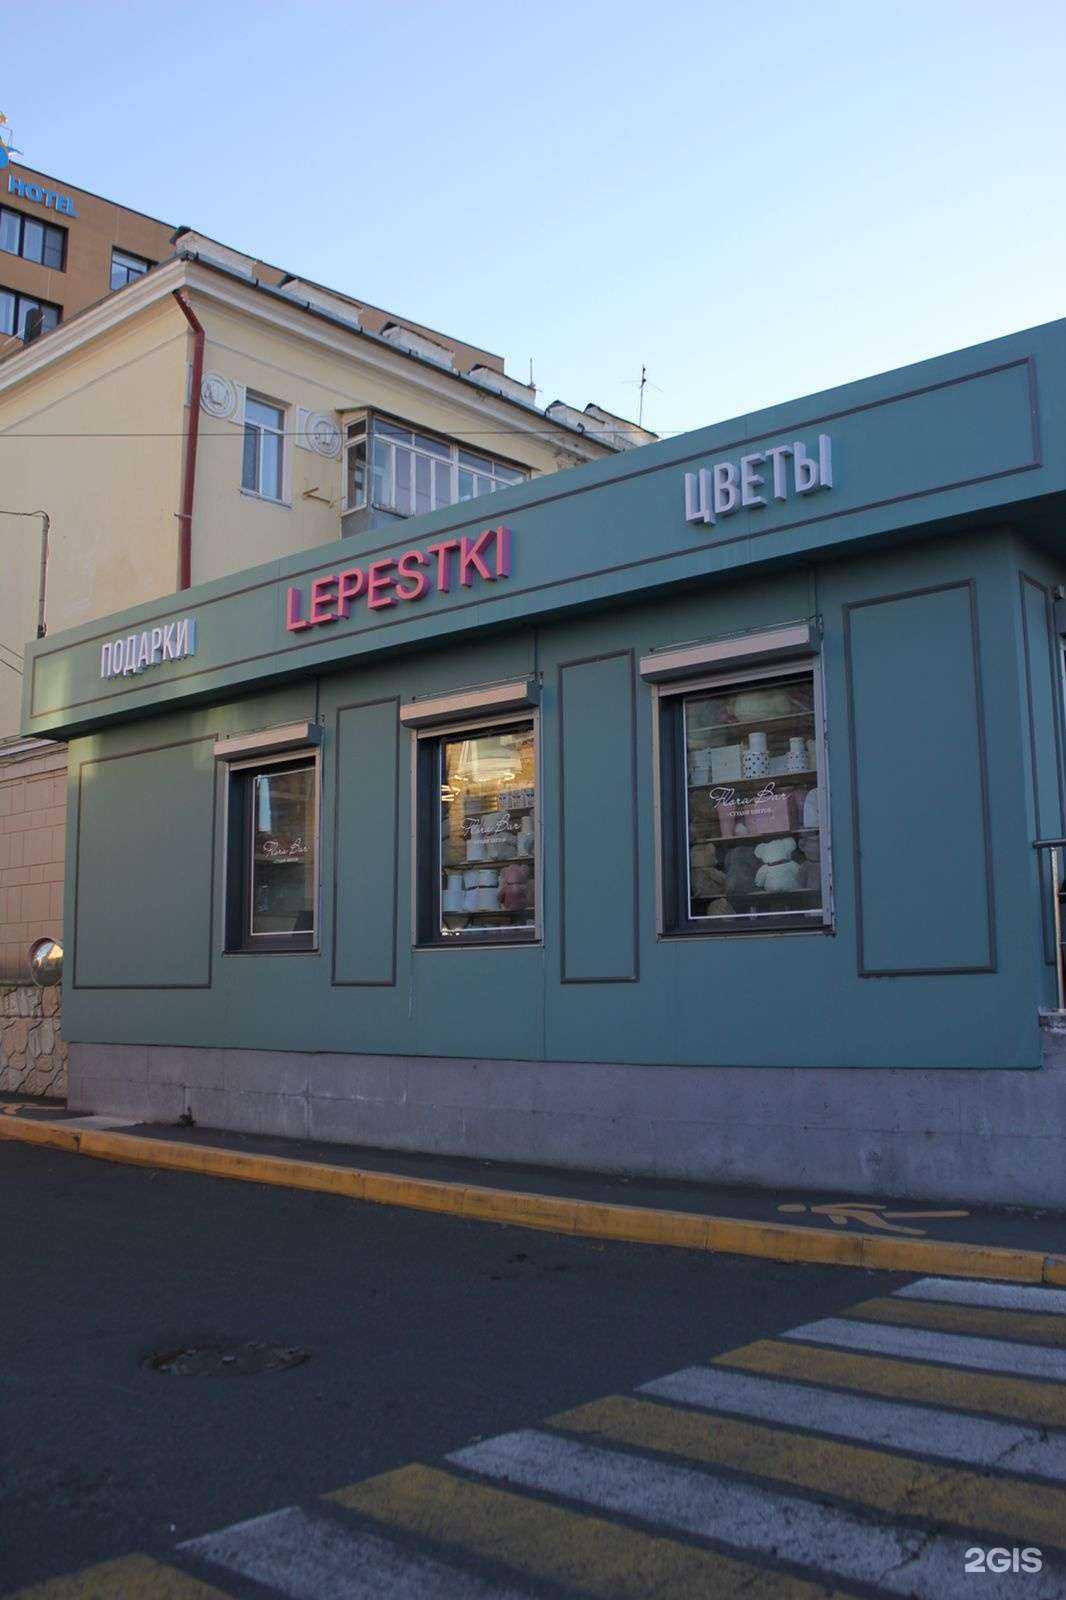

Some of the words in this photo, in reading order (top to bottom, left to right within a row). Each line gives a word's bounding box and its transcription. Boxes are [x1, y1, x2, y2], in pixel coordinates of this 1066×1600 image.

[8, 174, 79, 218] HOTEL
[684, 434, 832, 525] ЦВЕТЫ
[286, 525, 510, 632] LEPESTKI
[101, 617, 195, 679] ПОДАРКИ
